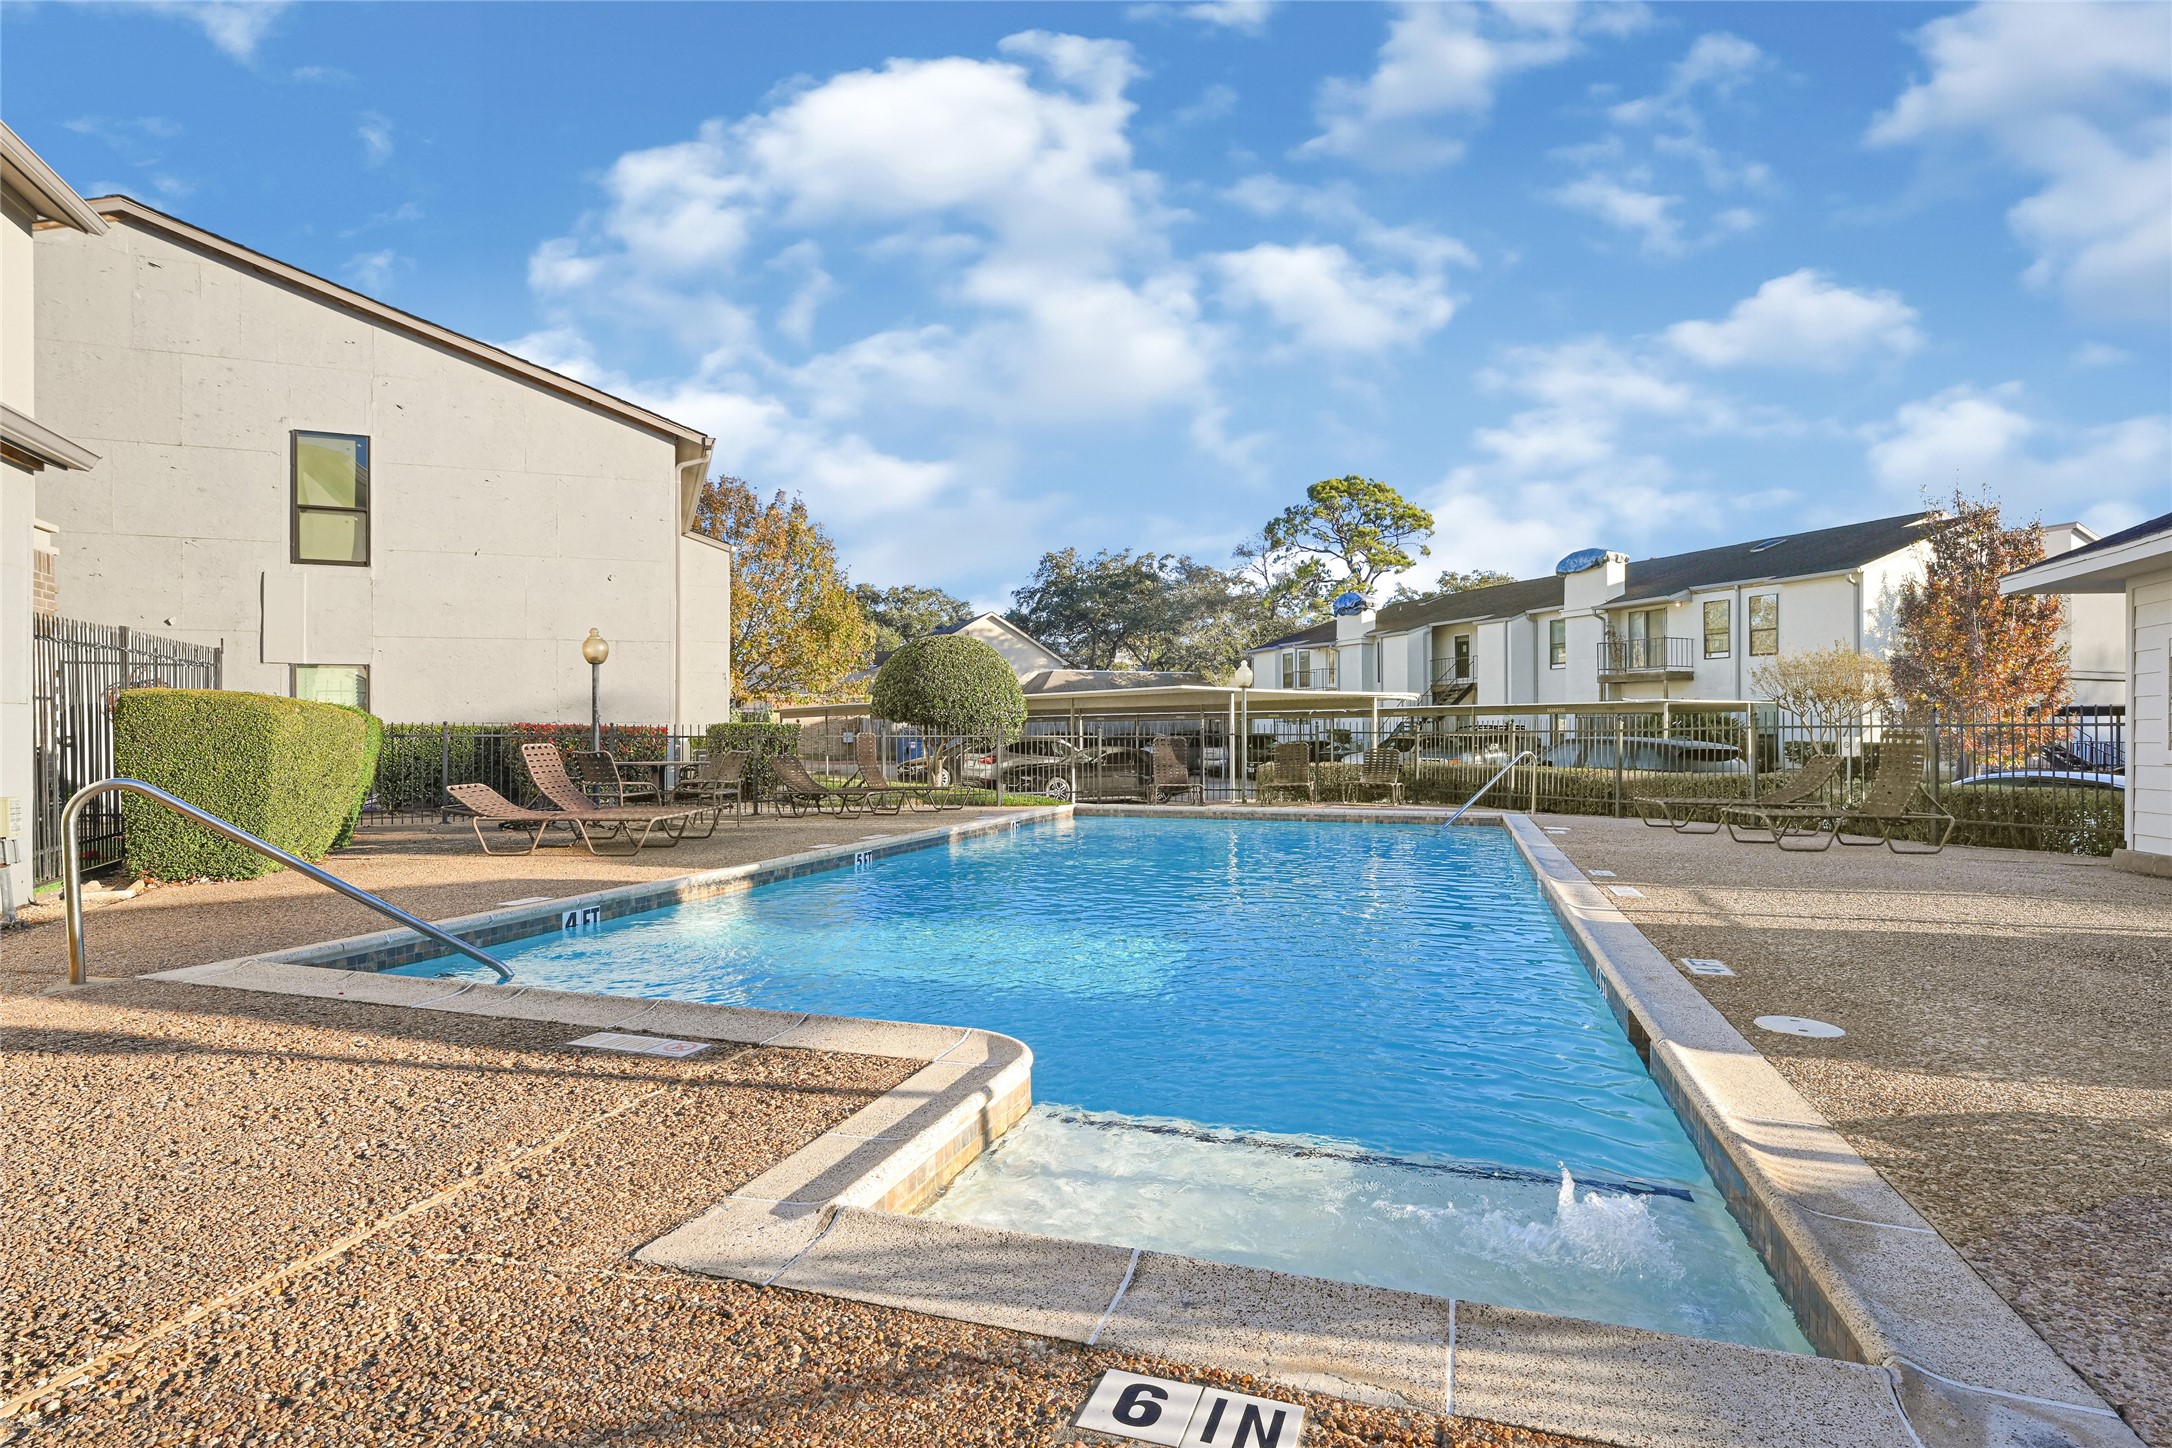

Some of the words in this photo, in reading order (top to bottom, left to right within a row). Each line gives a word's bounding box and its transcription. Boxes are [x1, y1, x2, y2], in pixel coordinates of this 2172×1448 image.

[565, 911, 578, 928] 4
[583, 907, 599, 924] FT
[1112, 1383, 1169, 1427] 6
[1200, 1397, 1287, 1448] IN
